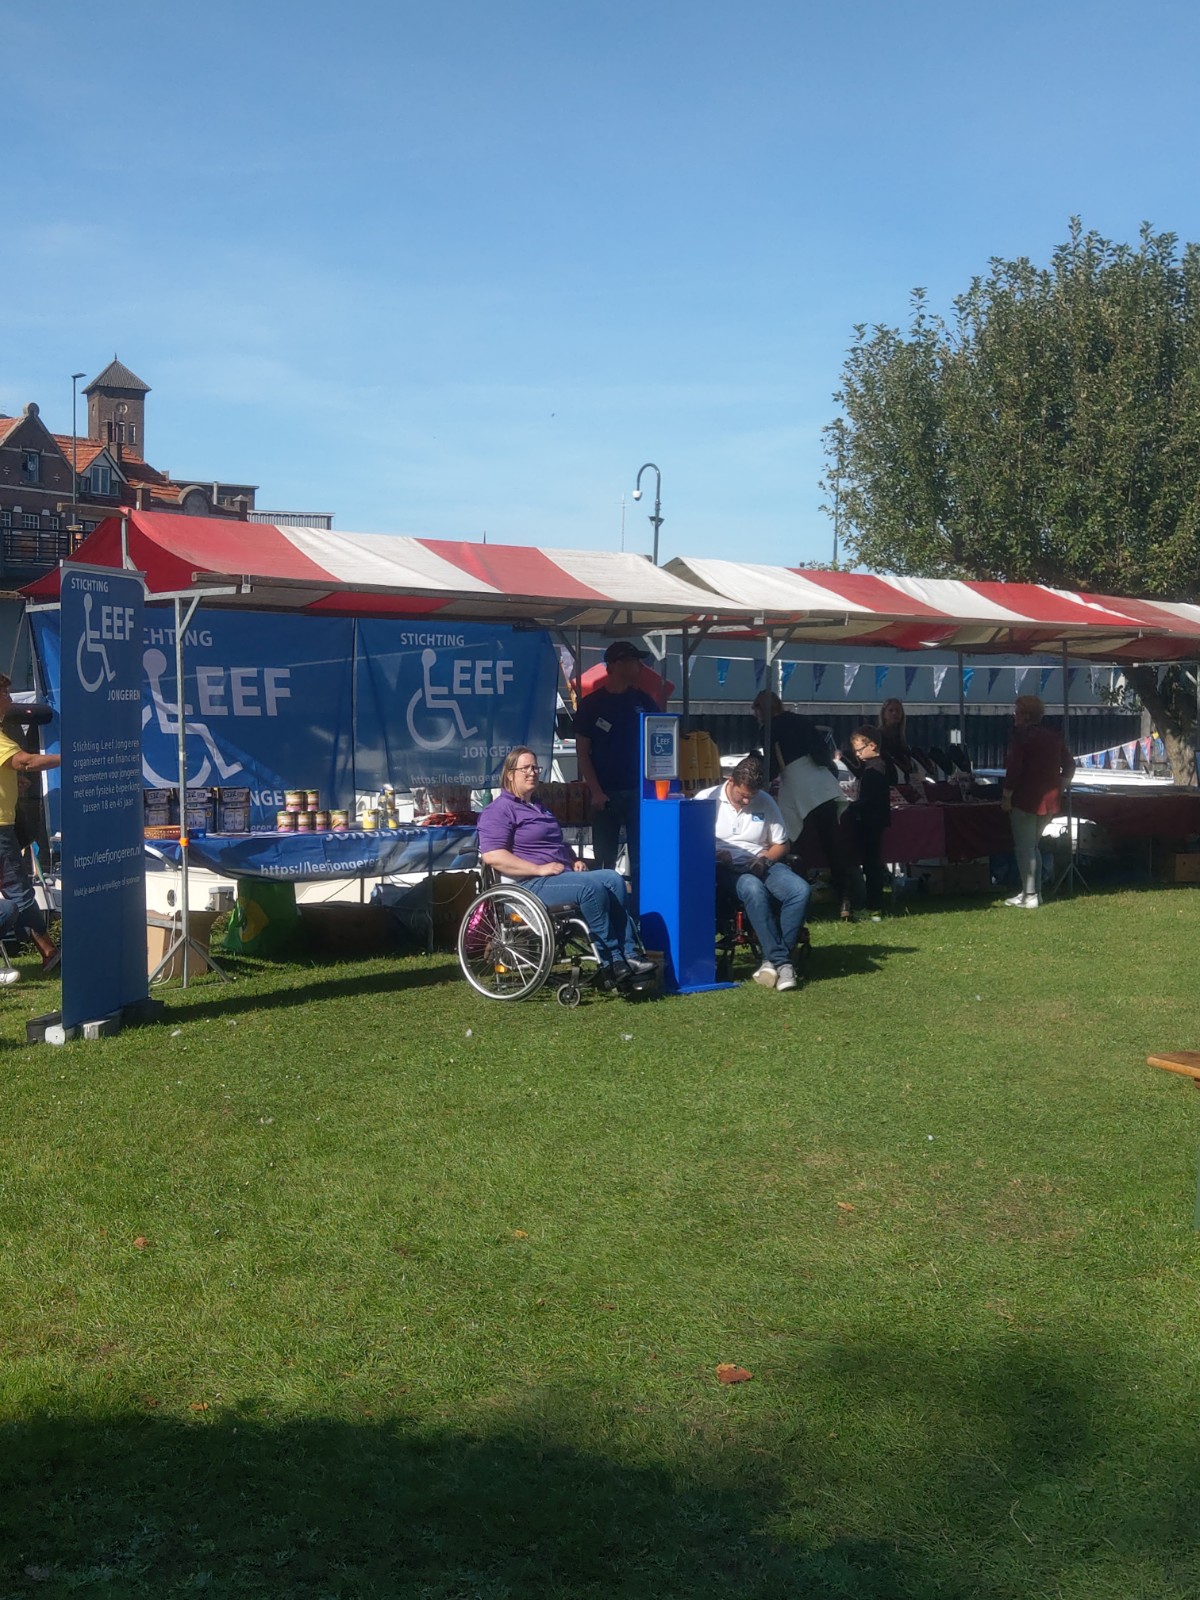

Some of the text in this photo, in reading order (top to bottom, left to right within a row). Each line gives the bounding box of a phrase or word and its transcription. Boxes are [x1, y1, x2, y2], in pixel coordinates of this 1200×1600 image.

[71, 577, 109, 593] STICHTING
[400, 633, 465, 647] STICHTING
[107, 689, 140, 701] JONGEREN
[72, 740, 100, 753] Stichting
[101, 738, 114, 750] Leef
[107, 756, 114, 764] en
[102, 799, 109, 810] 18
